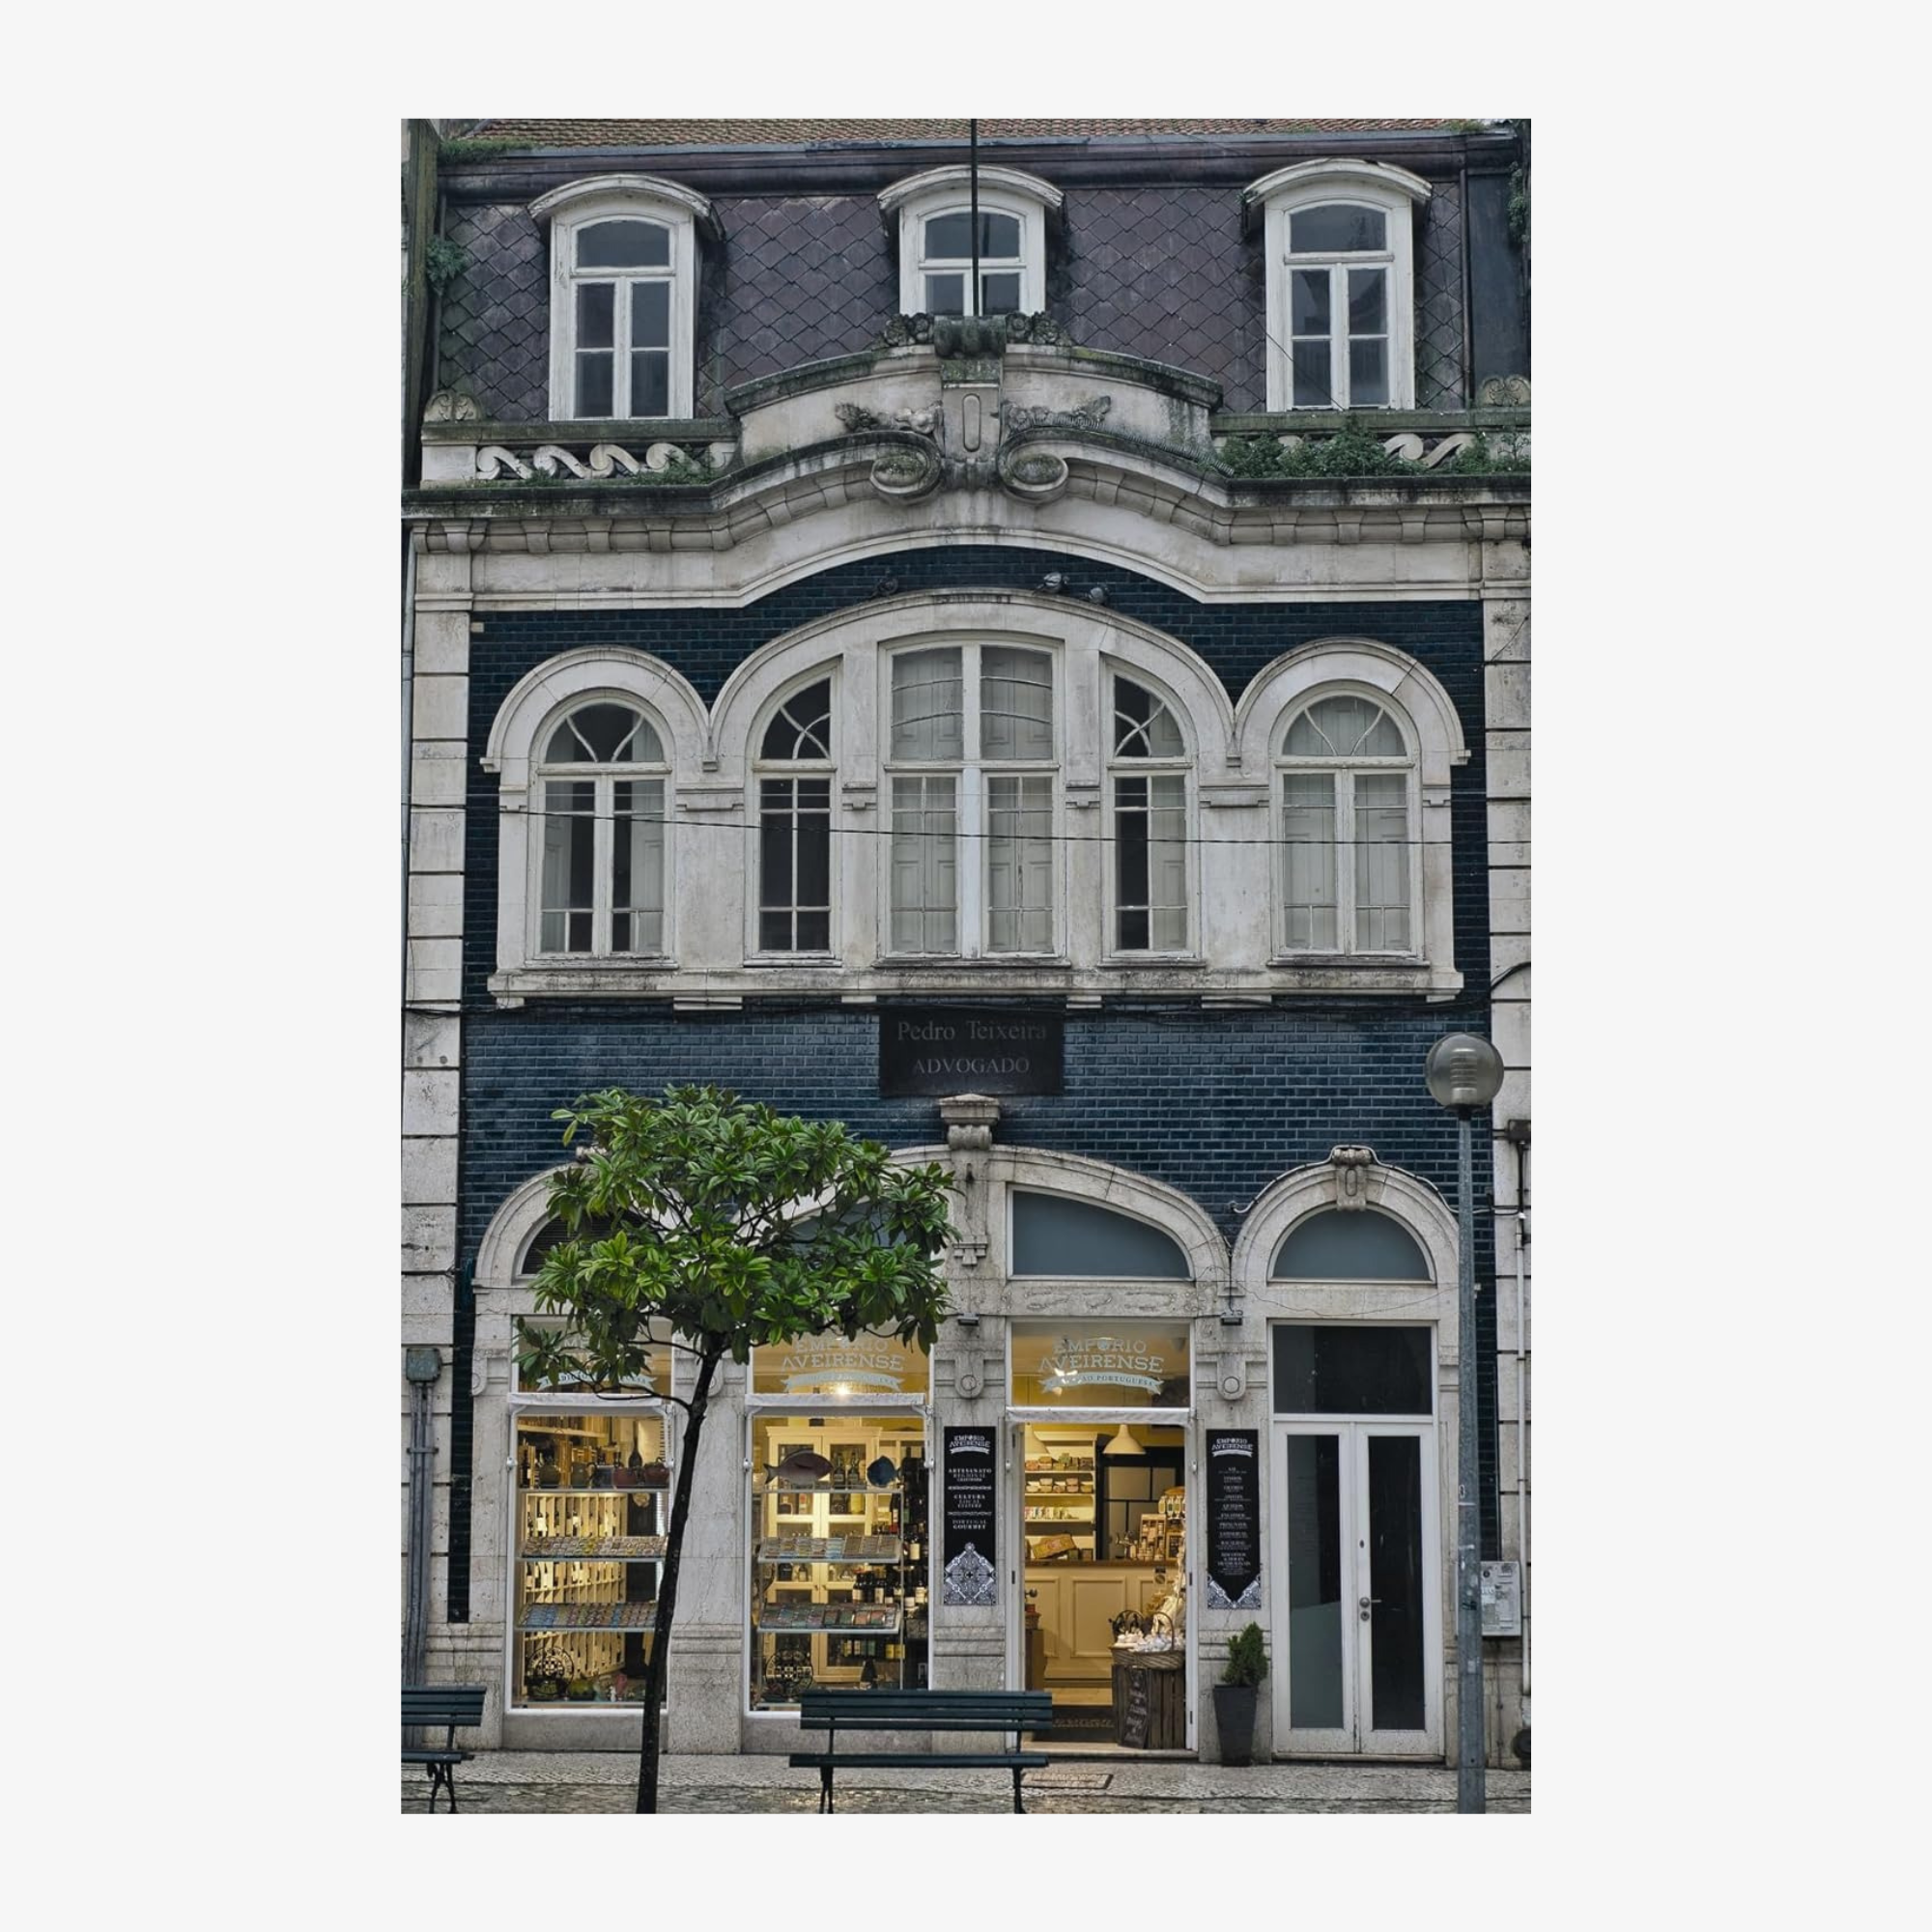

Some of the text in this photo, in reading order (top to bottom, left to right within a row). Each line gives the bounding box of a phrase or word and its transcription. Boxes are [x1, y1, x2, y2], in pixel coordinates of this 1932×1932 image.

[897, 1019, 1046, 1040] Pedro Teixeira
[913, 1057, 1030, 1074] ADVOGADO
[781, 1354, 906, 1372] AVEIRENSE
[1037, 1354, 1165, 1374] AVEIRENSE
